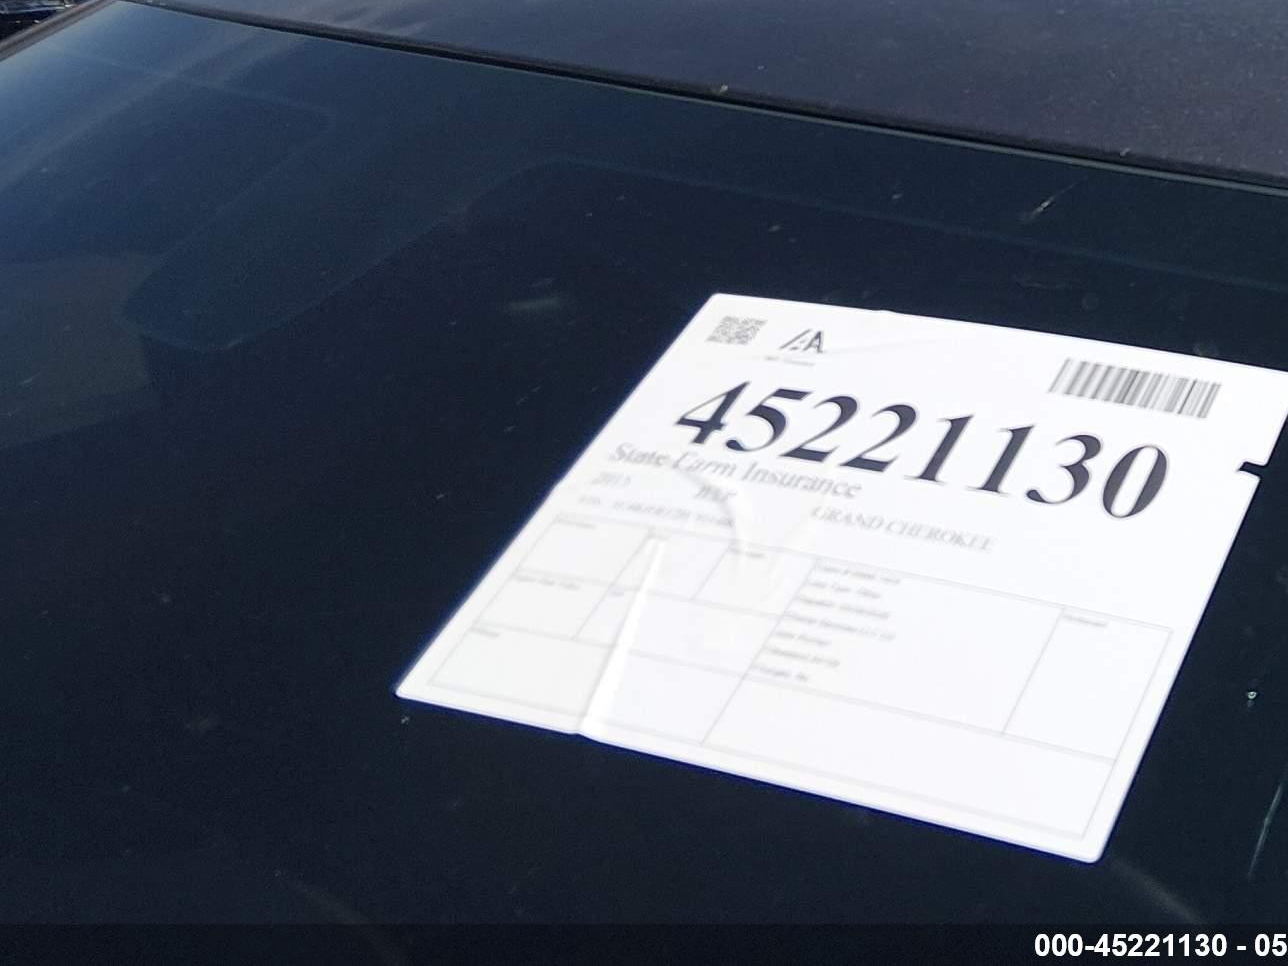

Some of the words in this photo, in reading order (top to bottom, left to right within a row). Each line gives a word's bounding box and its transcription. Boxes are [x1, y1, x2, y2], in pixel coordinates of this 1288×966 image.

[611, 442, 668, 468] State
[741, 460, 863, 500] Insurance
[673, 380, 1170, 519] 45221130
[809, 505, 884, 533] GRAND
[885, 518, 996, 552] CHEROKEE
